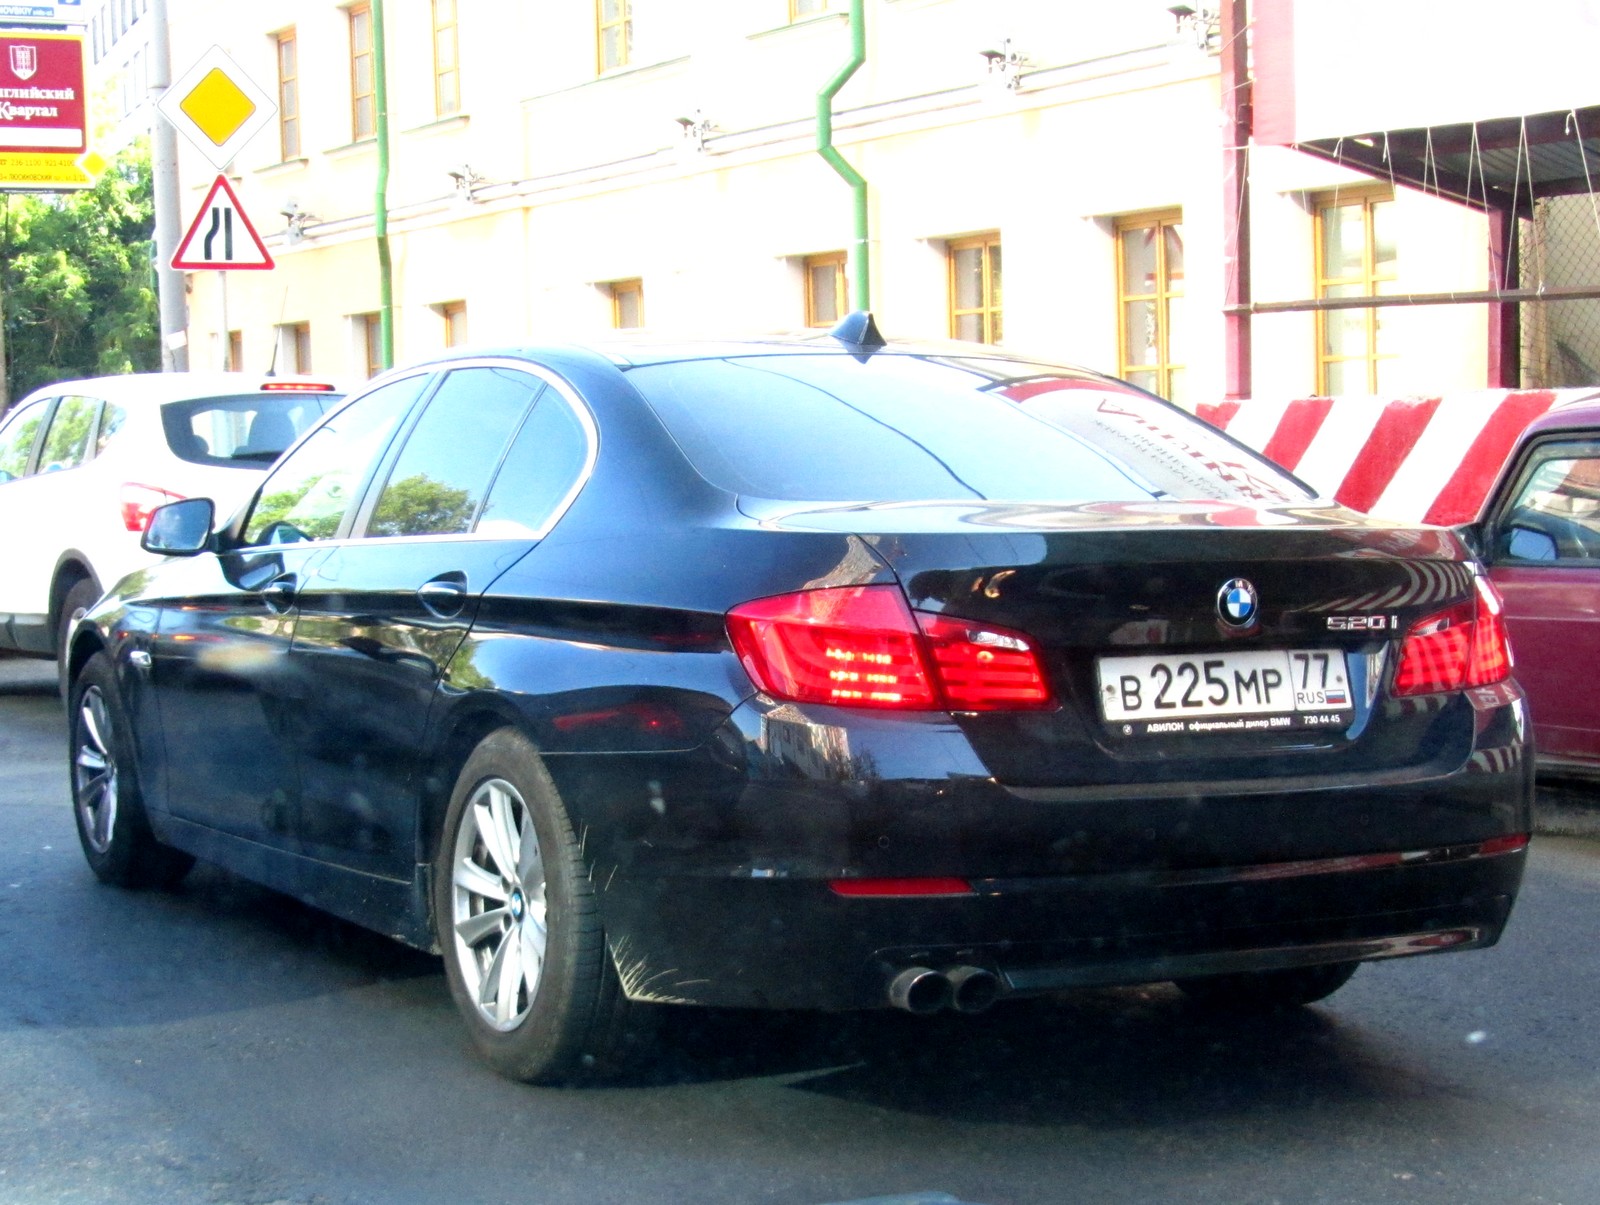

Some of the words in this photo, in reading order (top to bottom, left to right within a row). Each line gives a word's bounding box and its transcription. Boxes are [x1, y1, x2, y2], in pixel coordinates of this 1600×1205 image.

[0, 101, 58, 120] Квартал
[1293, 653, 1330, 689] 77
[1296, 691, 1325, 705] RUS
[1147, 722, 1184, 733] АВИЛОН
[1245, 719, 1270, 730] дилер
[1270, 716, 1291, 727] BMW
